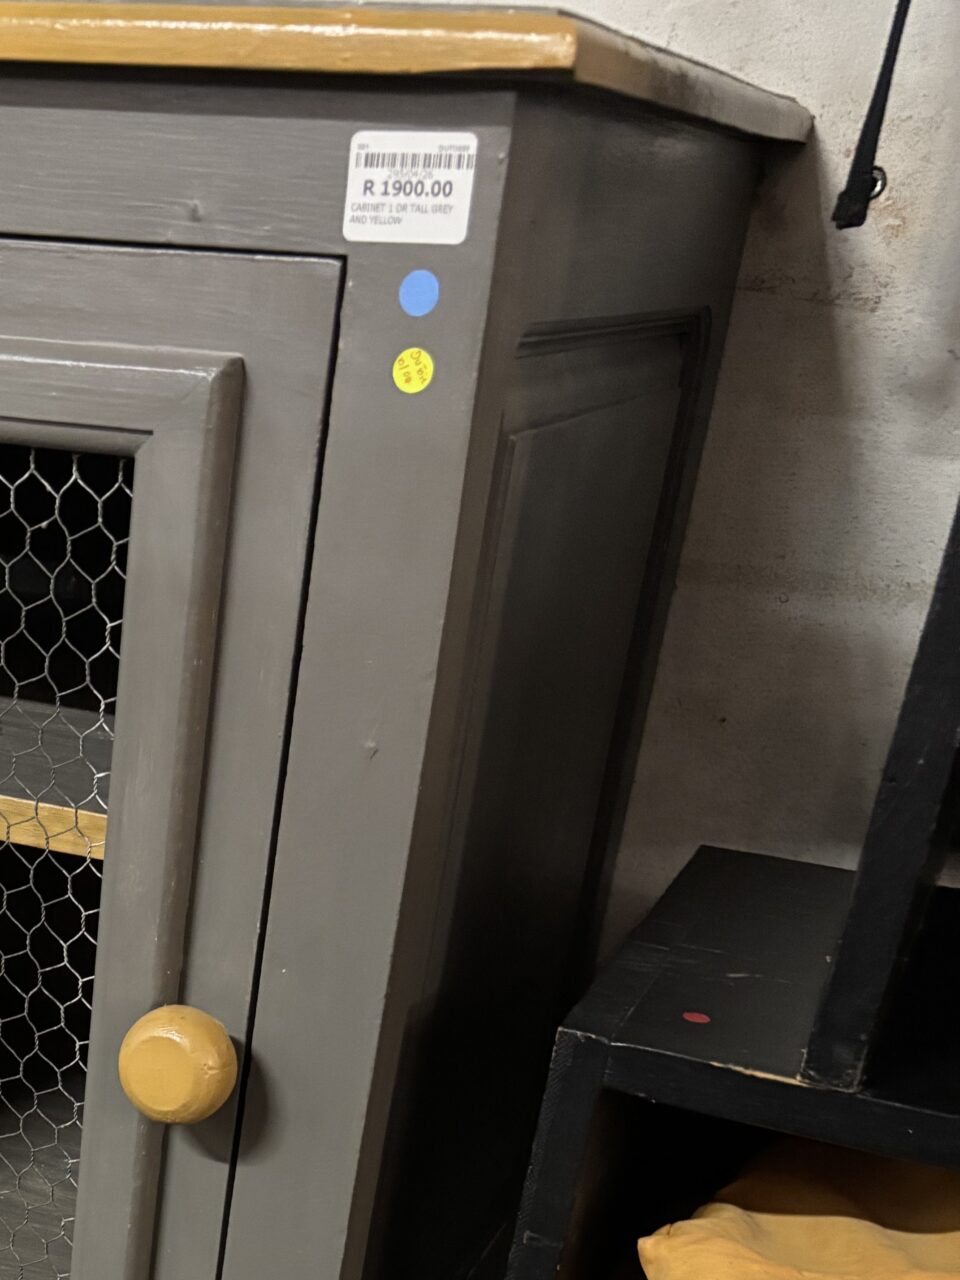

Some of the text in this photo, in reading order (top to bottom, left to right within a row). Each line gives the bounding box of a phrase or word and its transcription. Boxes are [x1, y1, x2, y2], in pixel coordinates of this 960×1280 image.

[363, 179, 453, 198] R 1900.00
[350, 202, 386, 213] CABINET
[410, 203, 428, 214] TALL
[431, 203, 454, 215] GREY
[349, 214, 402, 225] AND YELLOW
